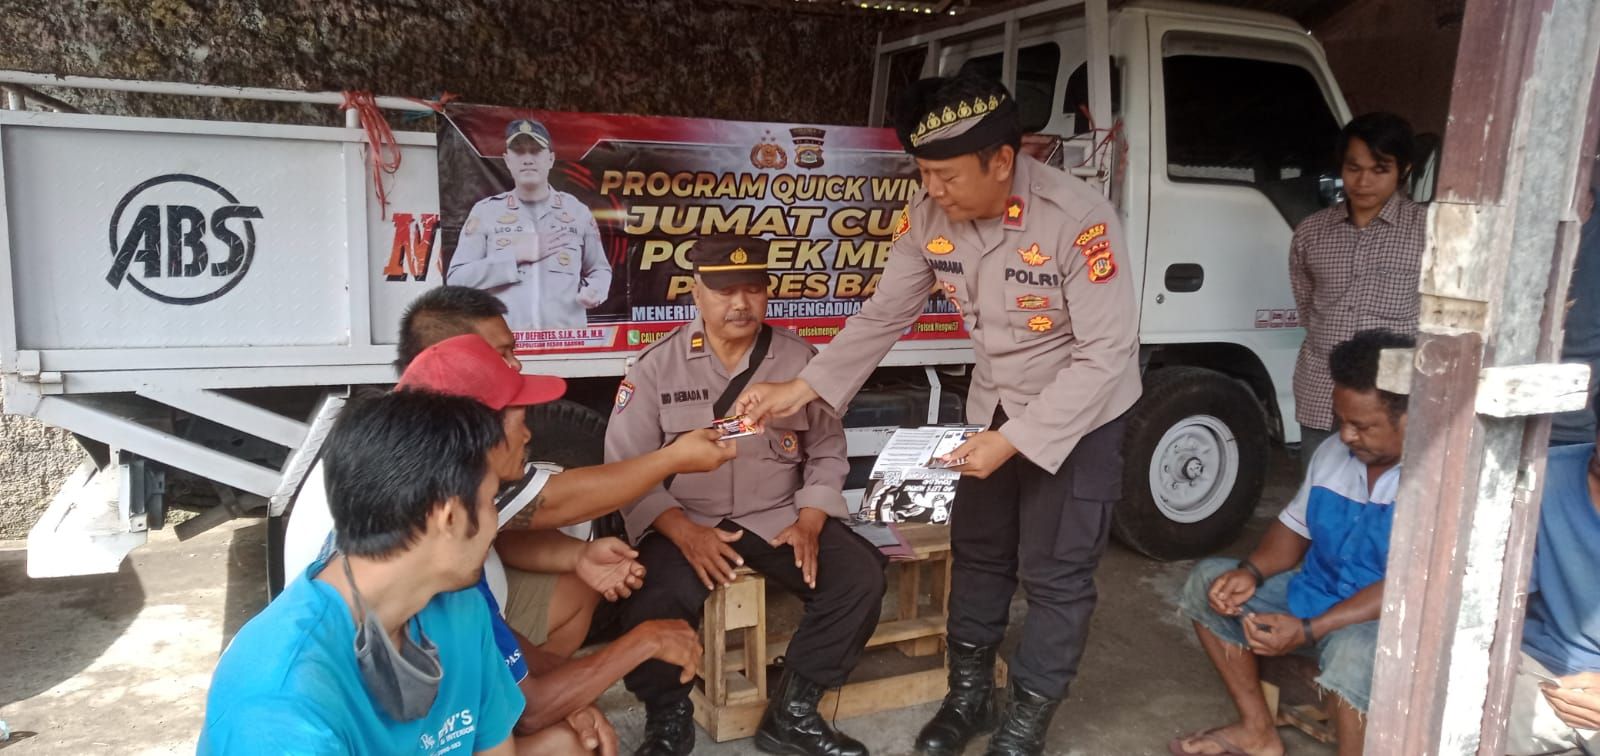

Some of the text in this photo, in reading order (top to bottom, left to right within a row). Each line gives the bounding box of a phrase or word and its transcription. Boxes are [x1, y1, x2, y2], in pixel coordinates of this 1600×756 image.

[600, 170, 769, 199] PROGRAM
[771, 173, 866, 205] QUICK
[624, 205, 826, 236] JUMAT
[105, 203, 264, 290] ABS
[1004, 267, 1059, 287] POLRI
